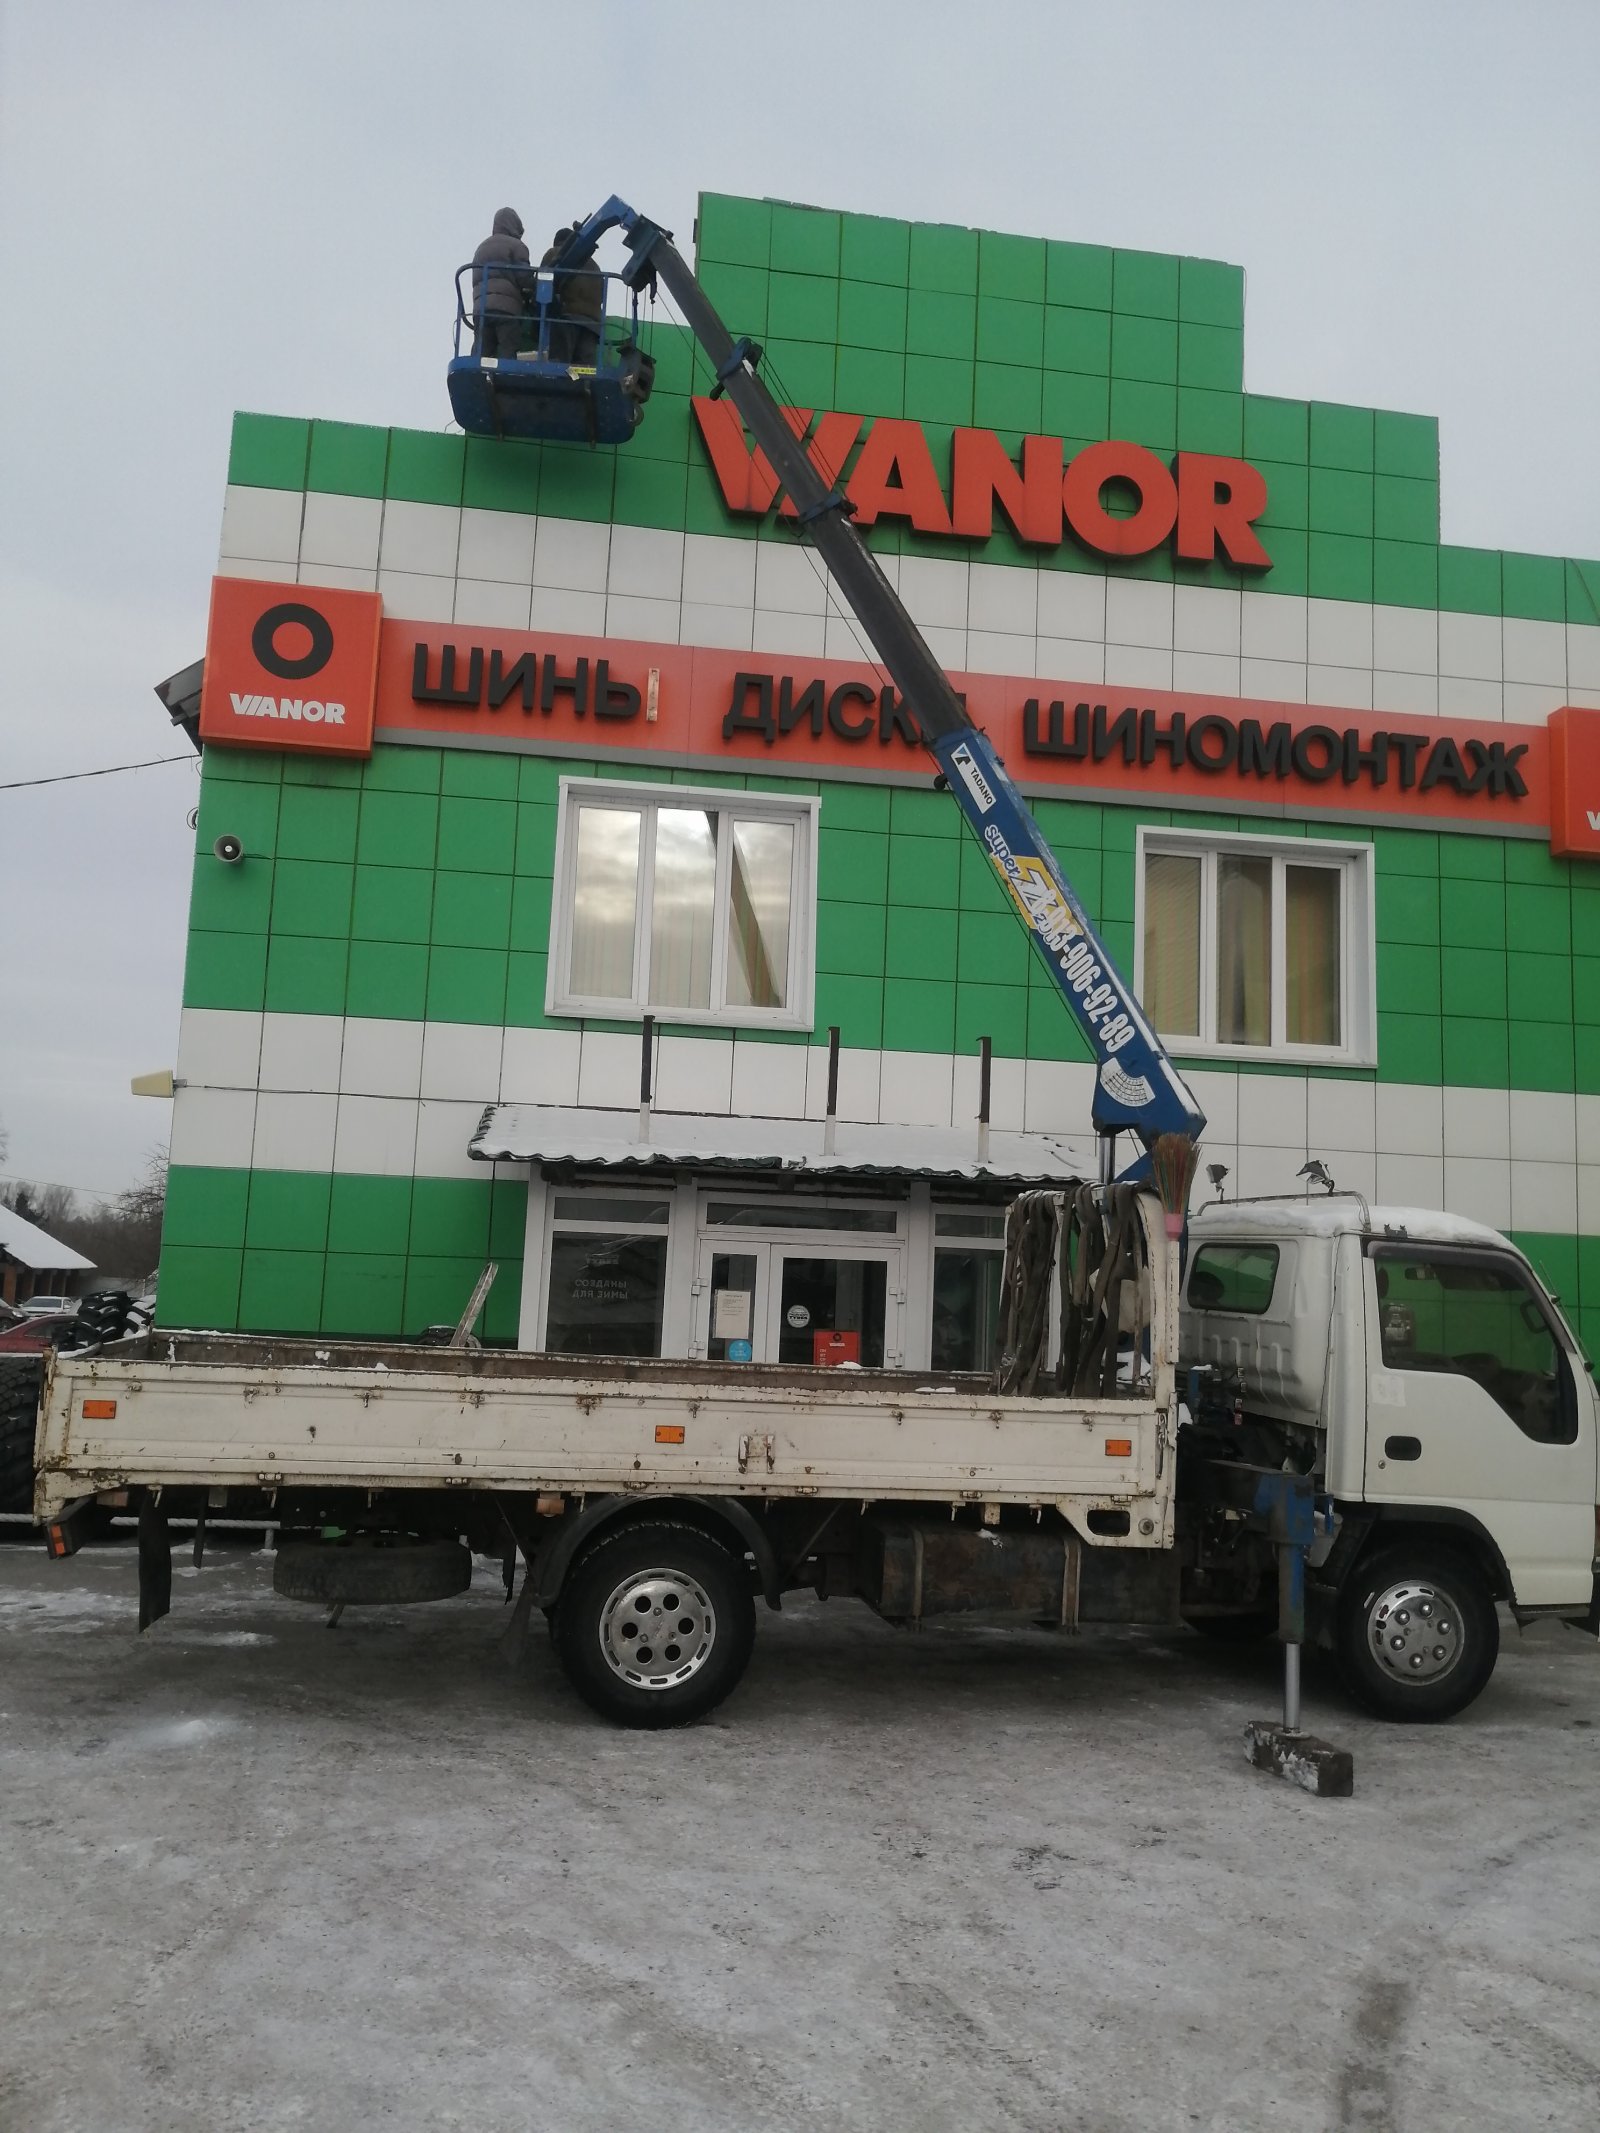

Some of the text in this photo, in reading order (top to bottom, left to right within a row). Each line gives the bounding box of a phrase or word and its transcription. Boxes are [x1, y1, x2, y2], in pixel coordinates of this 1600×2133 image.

[229, 693, 346, 724] VIANOR
[722, 672, 967, 746] ДИСК
[1023, 698, 1530, 798] ШИНОМОНТАЖ
[969, 766, 993, 806] TADANO
